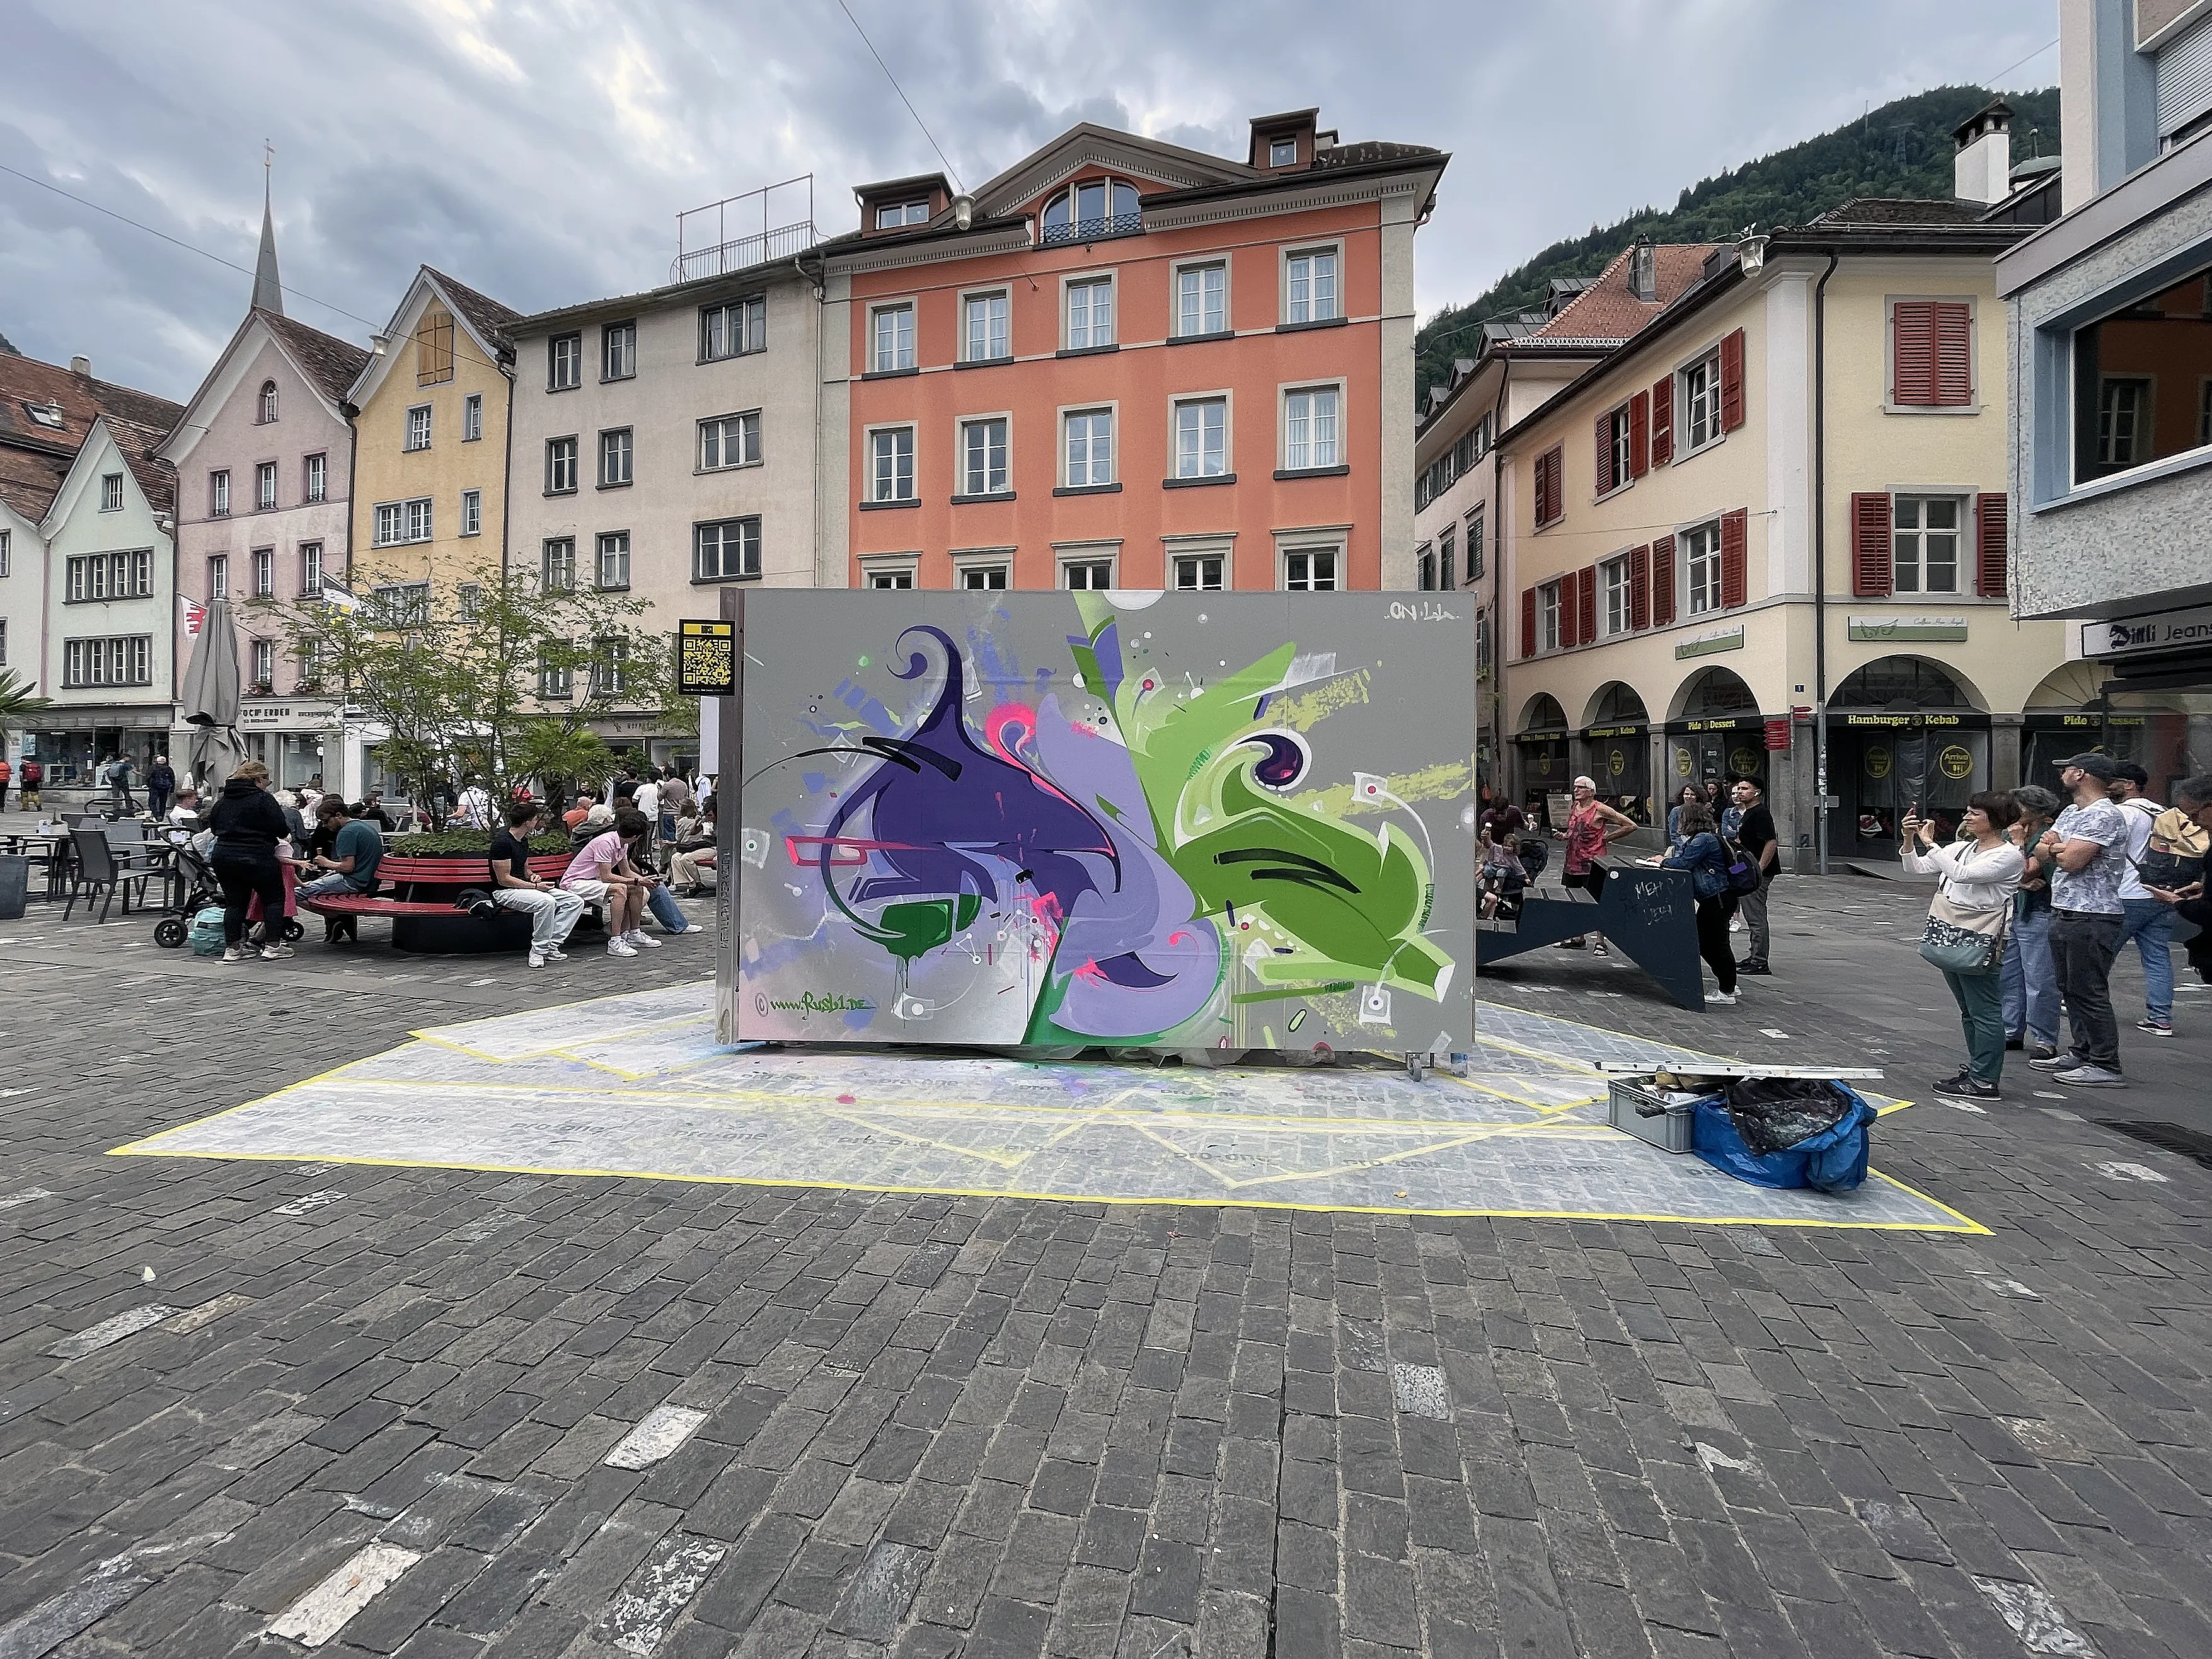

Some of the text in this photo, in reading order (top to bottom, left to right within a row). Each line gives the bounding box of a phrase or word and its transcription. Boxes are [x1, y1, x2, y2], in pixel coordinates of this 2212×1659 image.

[1710, 719, 1736, 729] Dessert
[1848, 715, 1959, 725] Hamburger Kebab
